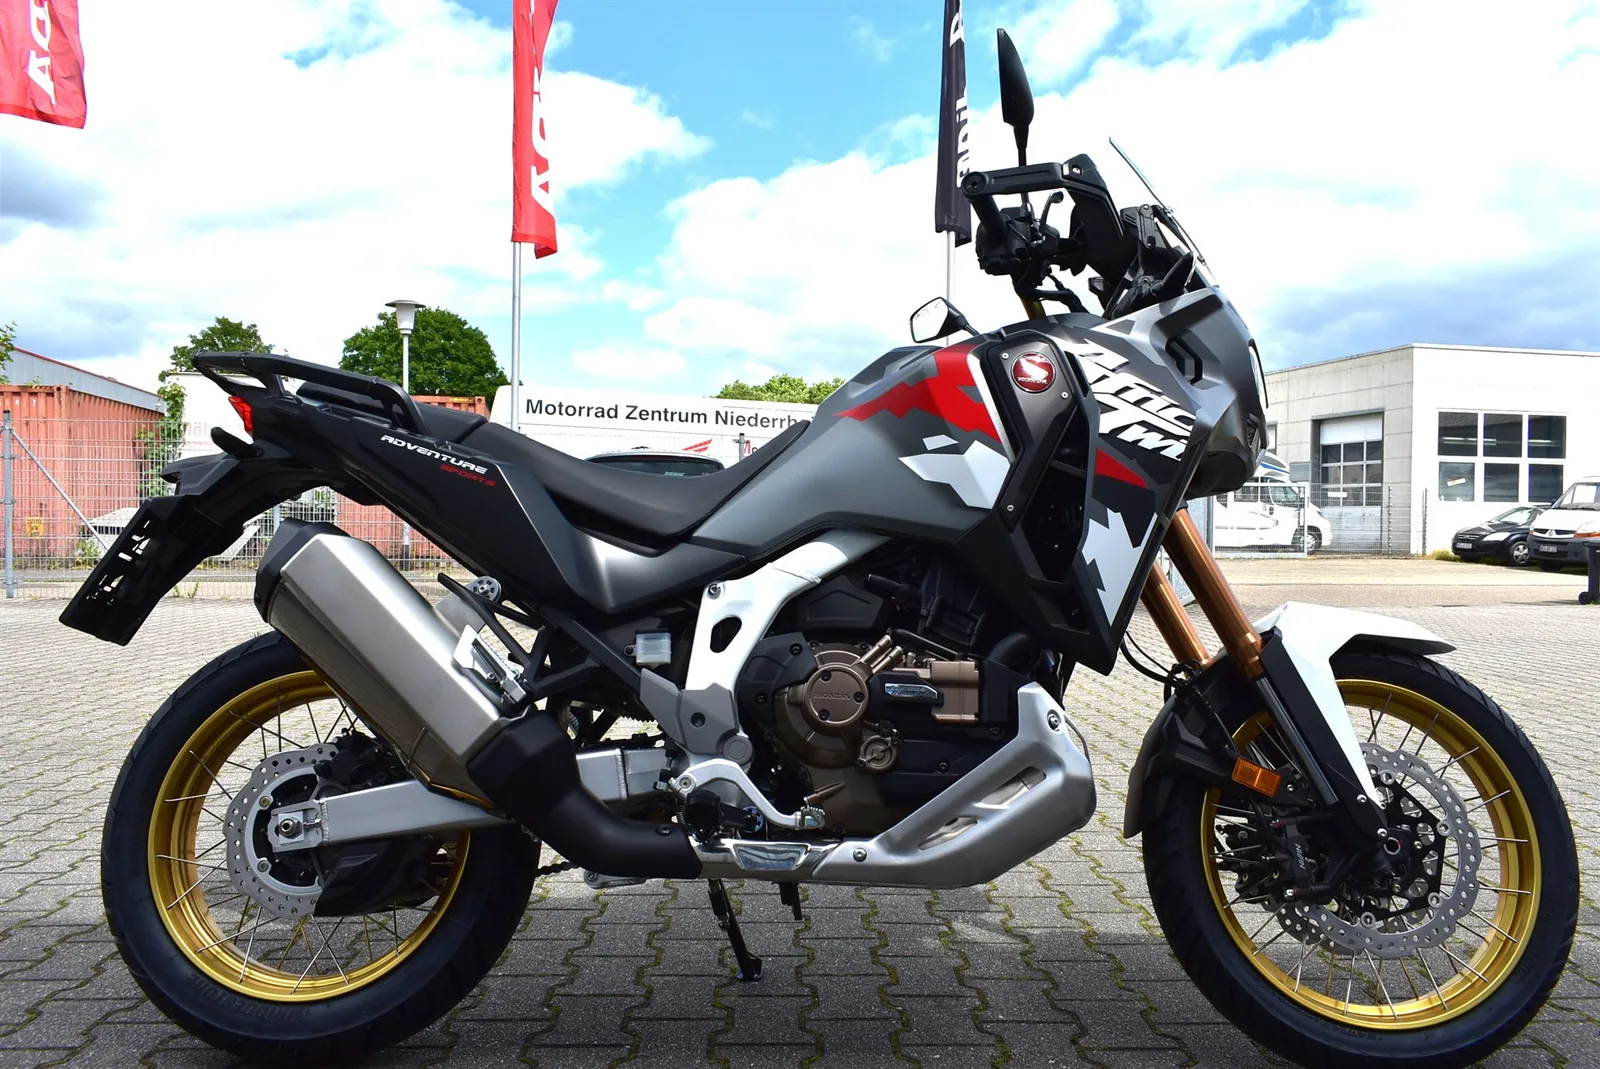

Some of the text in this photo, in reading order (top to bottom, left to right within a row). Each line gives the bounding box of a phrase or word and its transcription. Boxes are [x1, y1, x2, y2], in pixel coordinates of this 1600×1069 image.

[525, 398, 815, 429] Motorrad Zentrum Niederrh
[1094, 392, 1192, 462] Twi
[380, 434, 488, 475] ADVENTURE
[439, 463, 497, 487] SPORTS
[813, 691, 852, 701] HONDA
